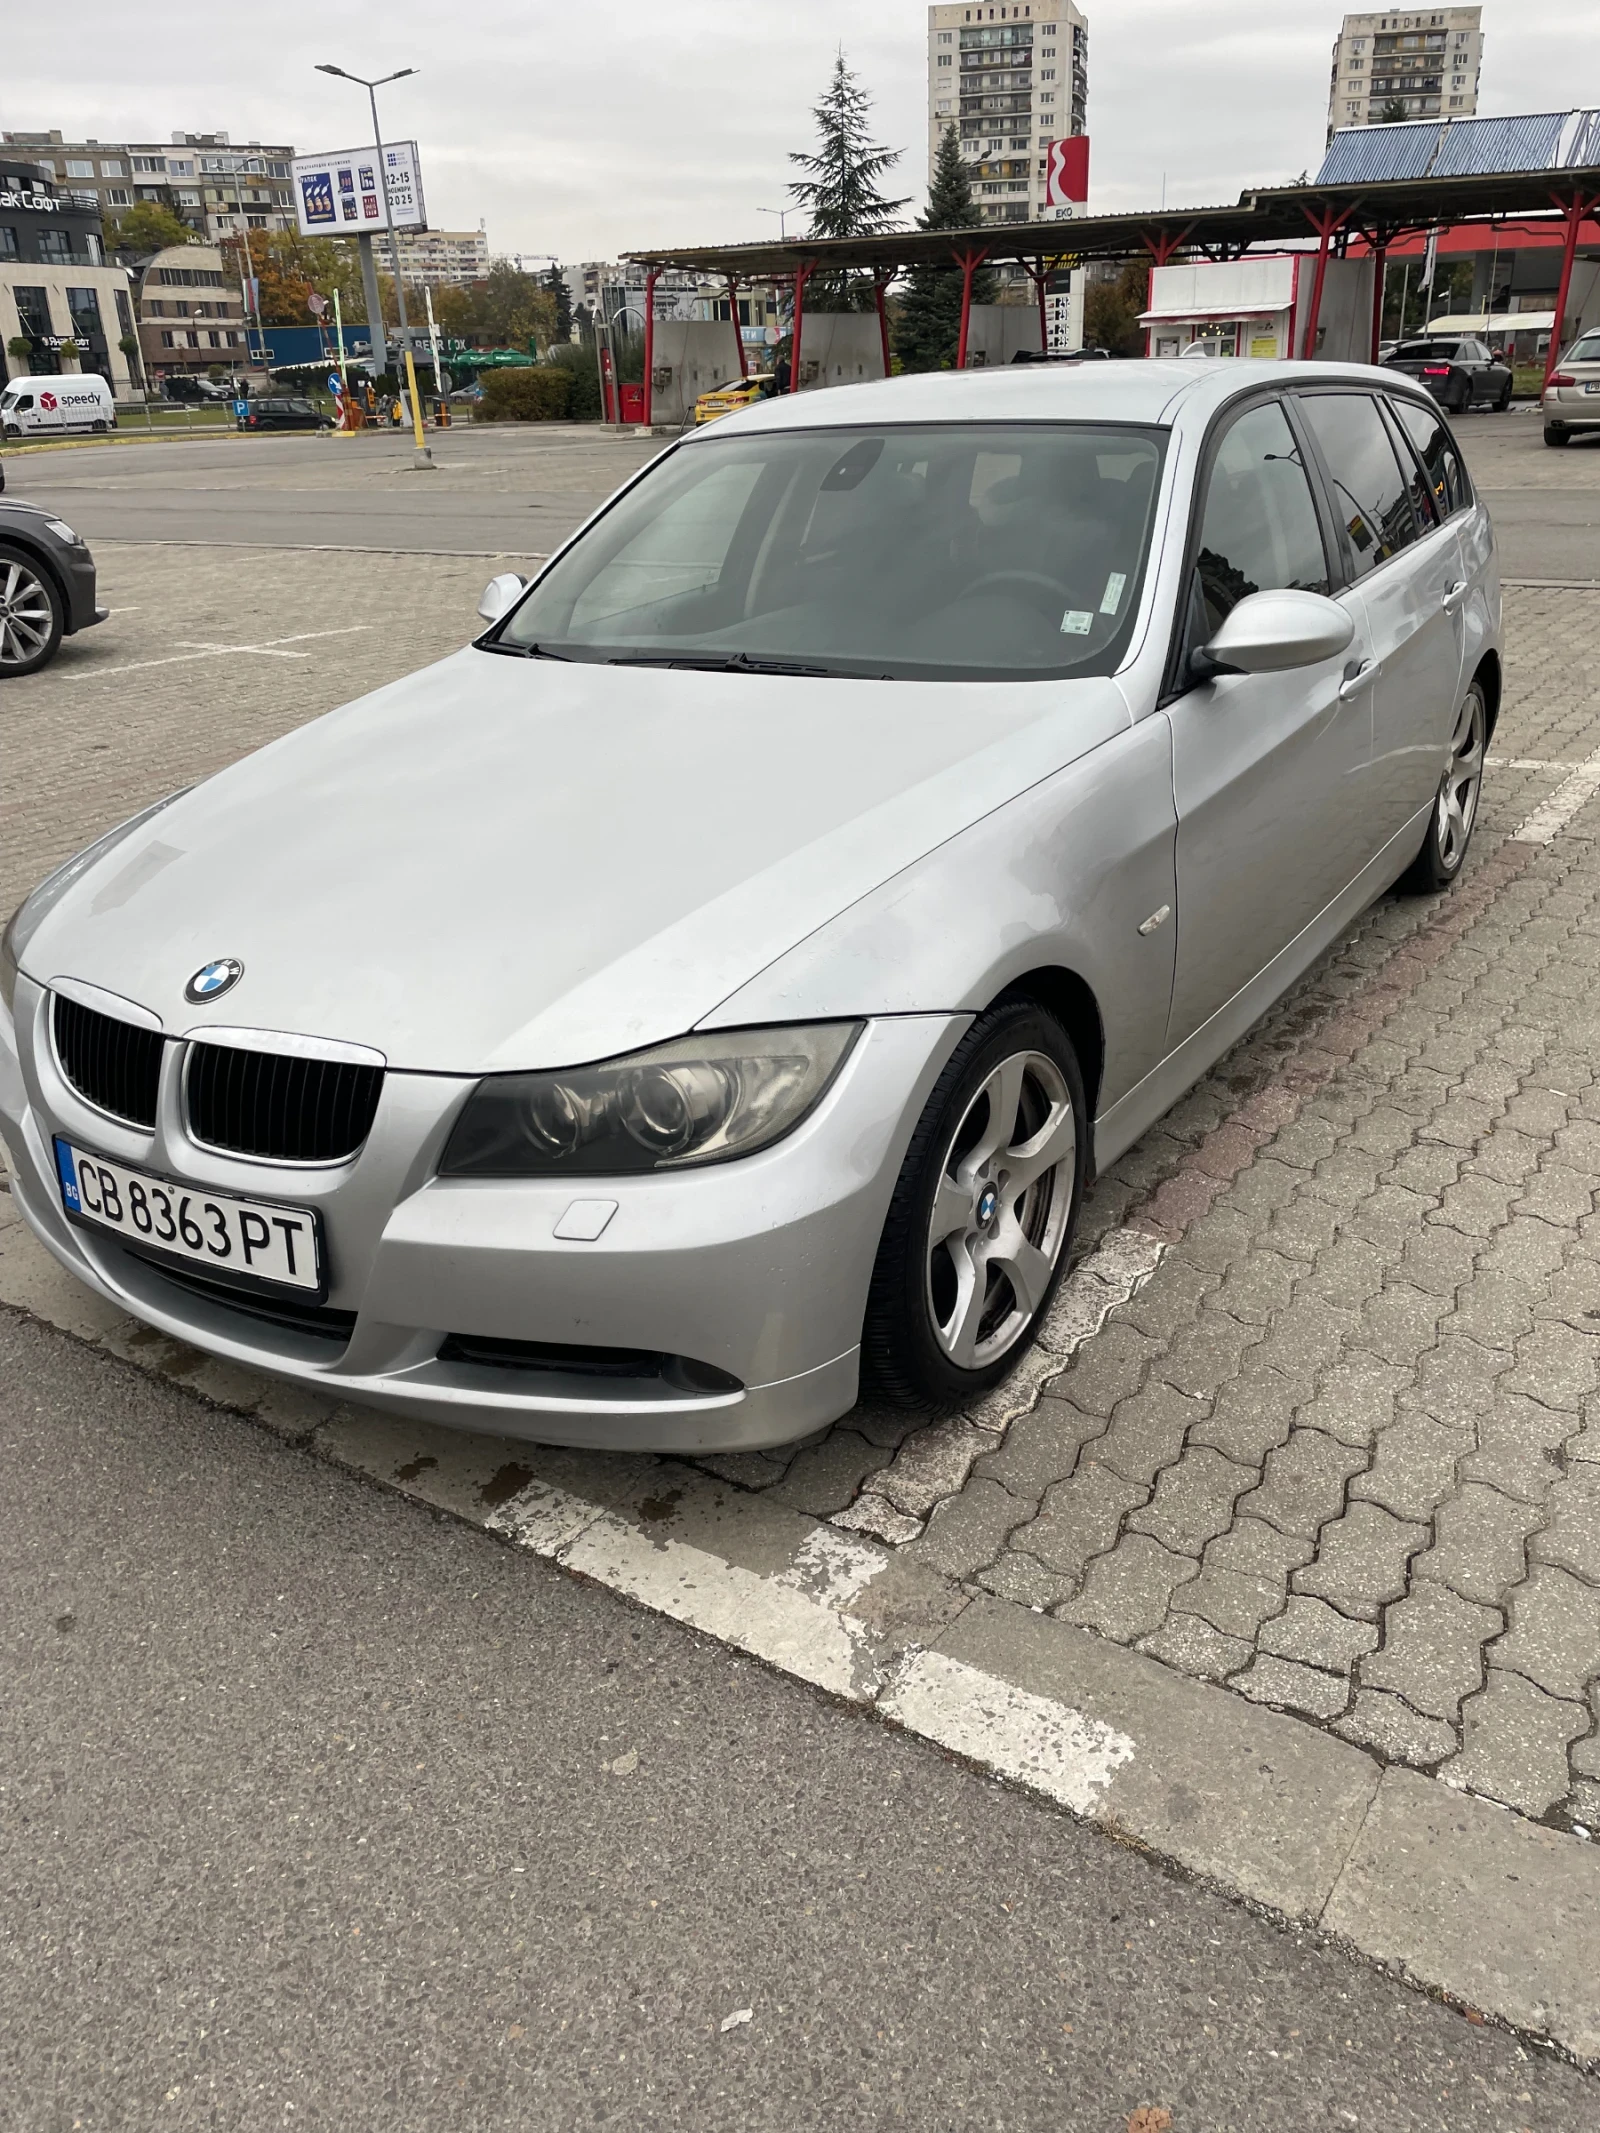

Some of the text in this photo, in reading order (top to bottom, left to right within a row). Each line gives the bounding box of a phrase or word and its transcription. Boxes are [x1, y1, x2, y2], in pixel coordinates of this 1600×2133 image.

[386, 172, 410, 185] 12-15
[388, 194, 413, 206] 2025
[1056, 207, 1073, 218] EKO
[415, 339, 445, 351] BER
[61, 392, 101, 407] speedy
[64, 1182, 79, 1200] BG
[78, 1159, 304, 1276] CB 8363 PT
